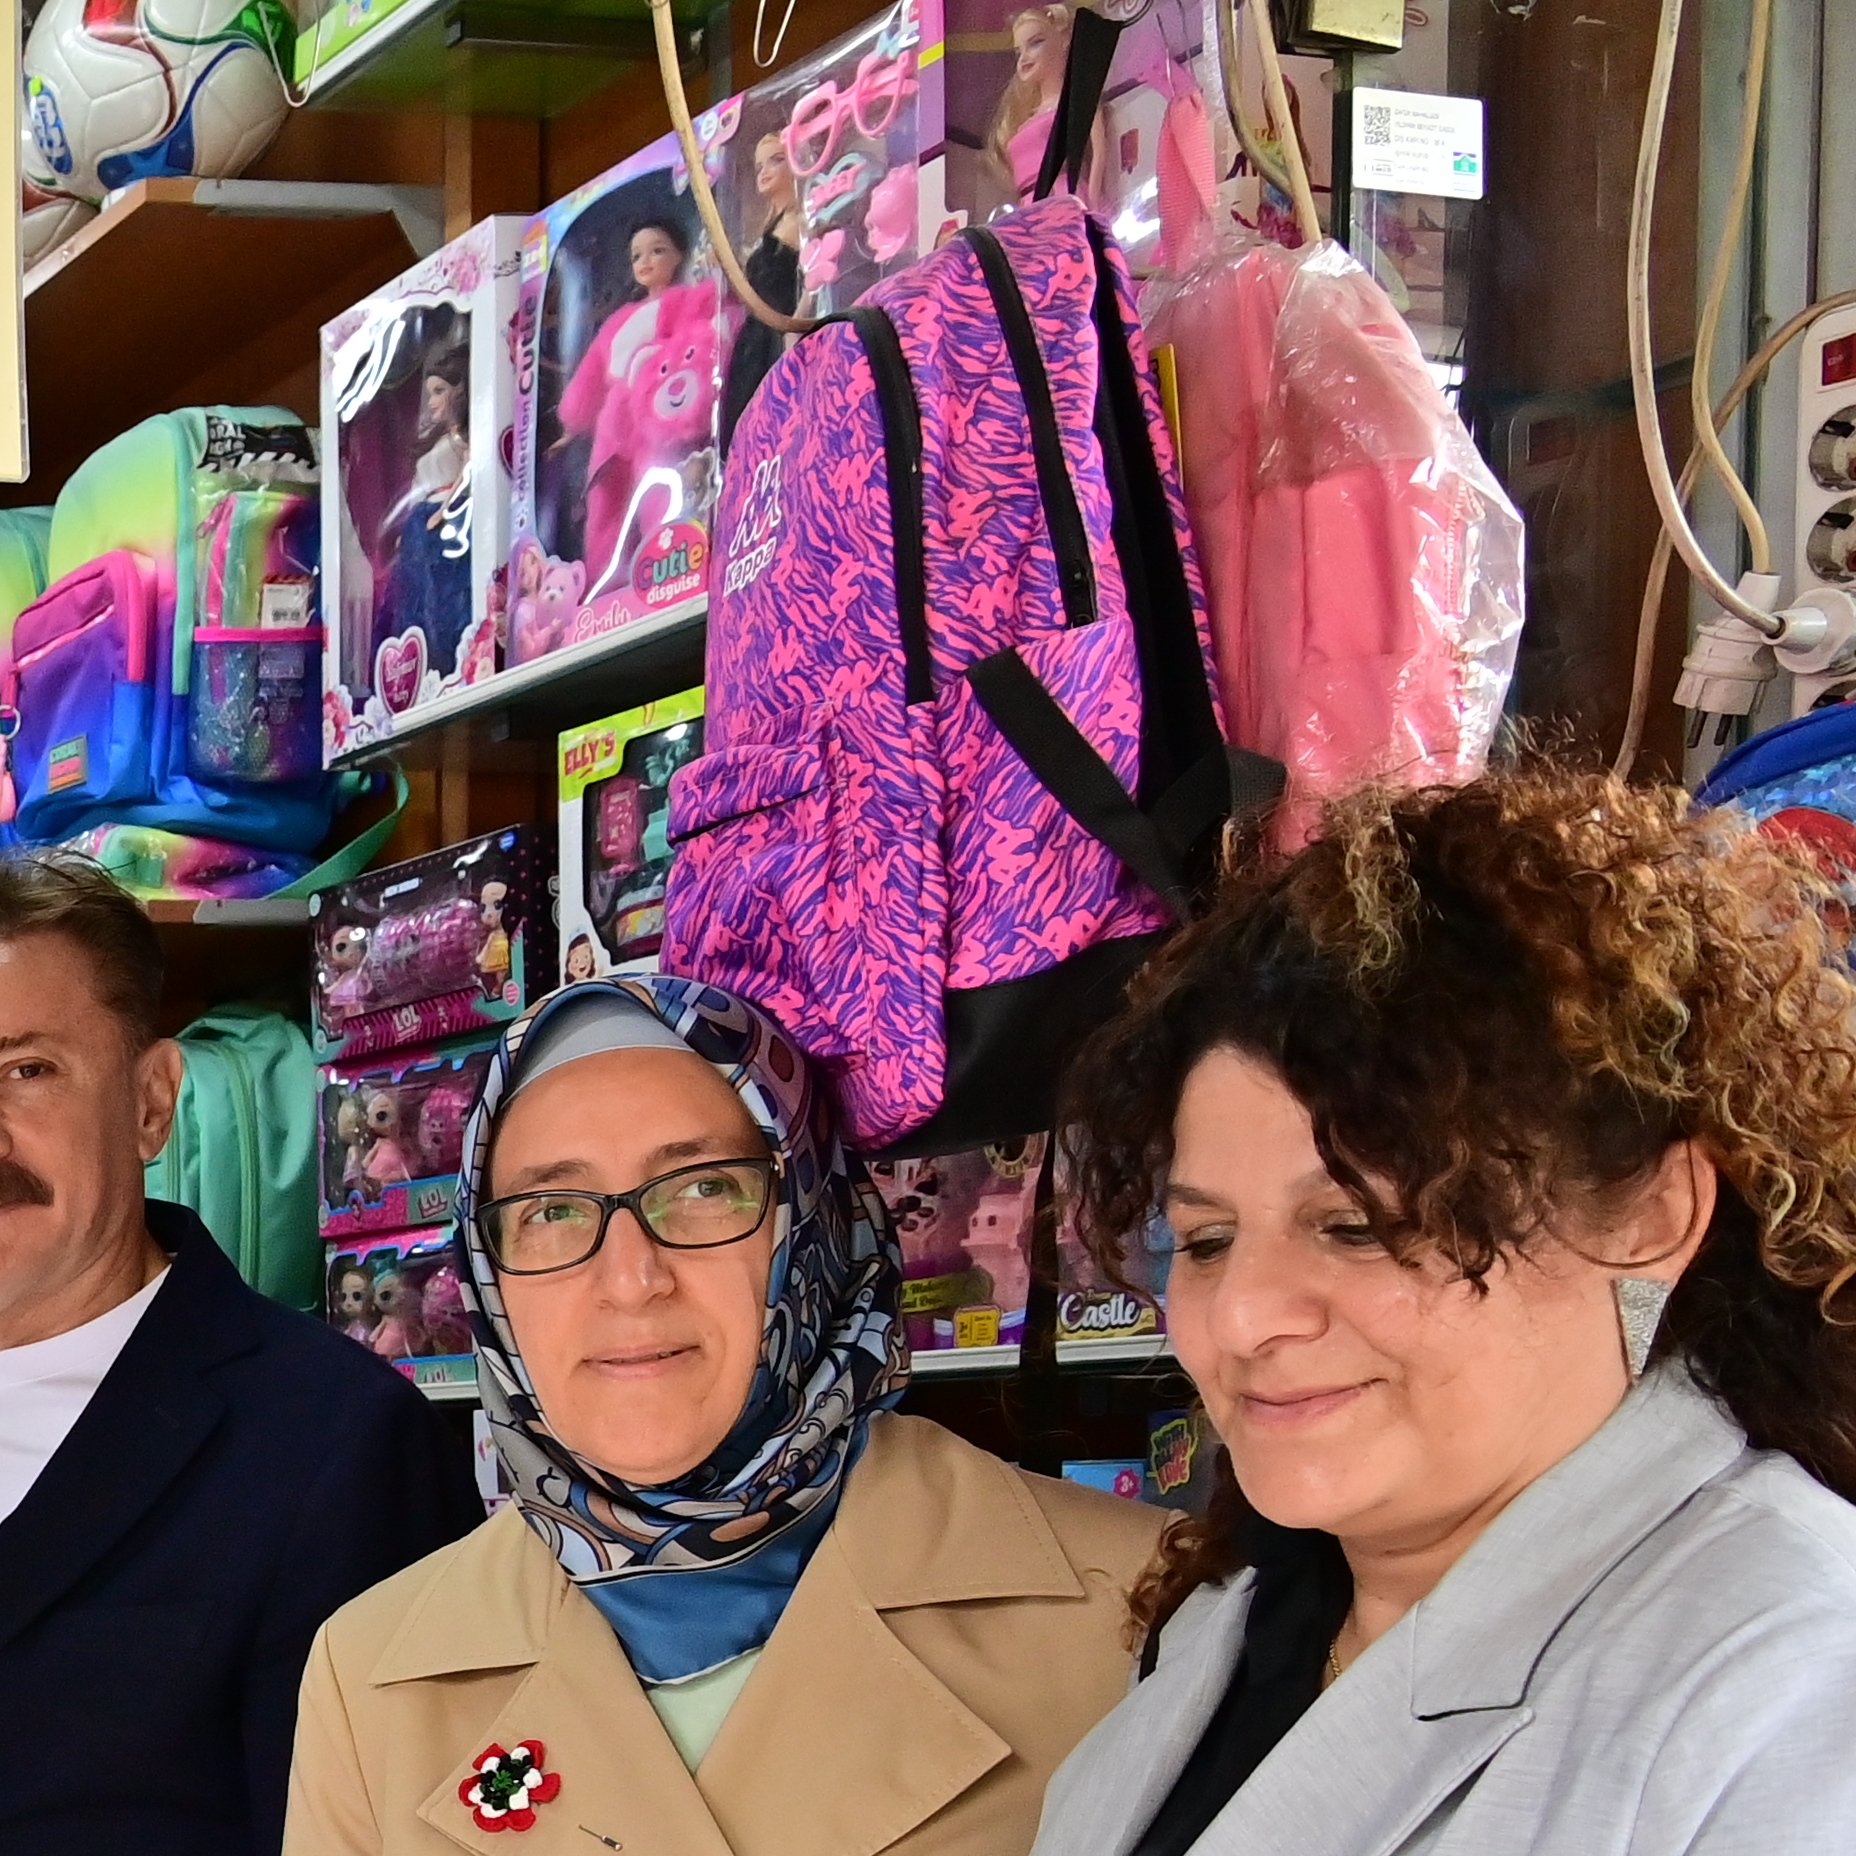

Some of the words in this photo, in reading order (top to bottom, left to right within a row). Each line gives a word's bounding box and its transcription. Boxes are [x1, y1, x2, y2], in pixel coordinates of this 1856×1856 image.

[638, 540, 705, 591] Cutie
[646, 572, 701, 606] disguise
[563, 730, 617, 777] ELLY'S
[1058, 1292, 1140, 1333] Castle
